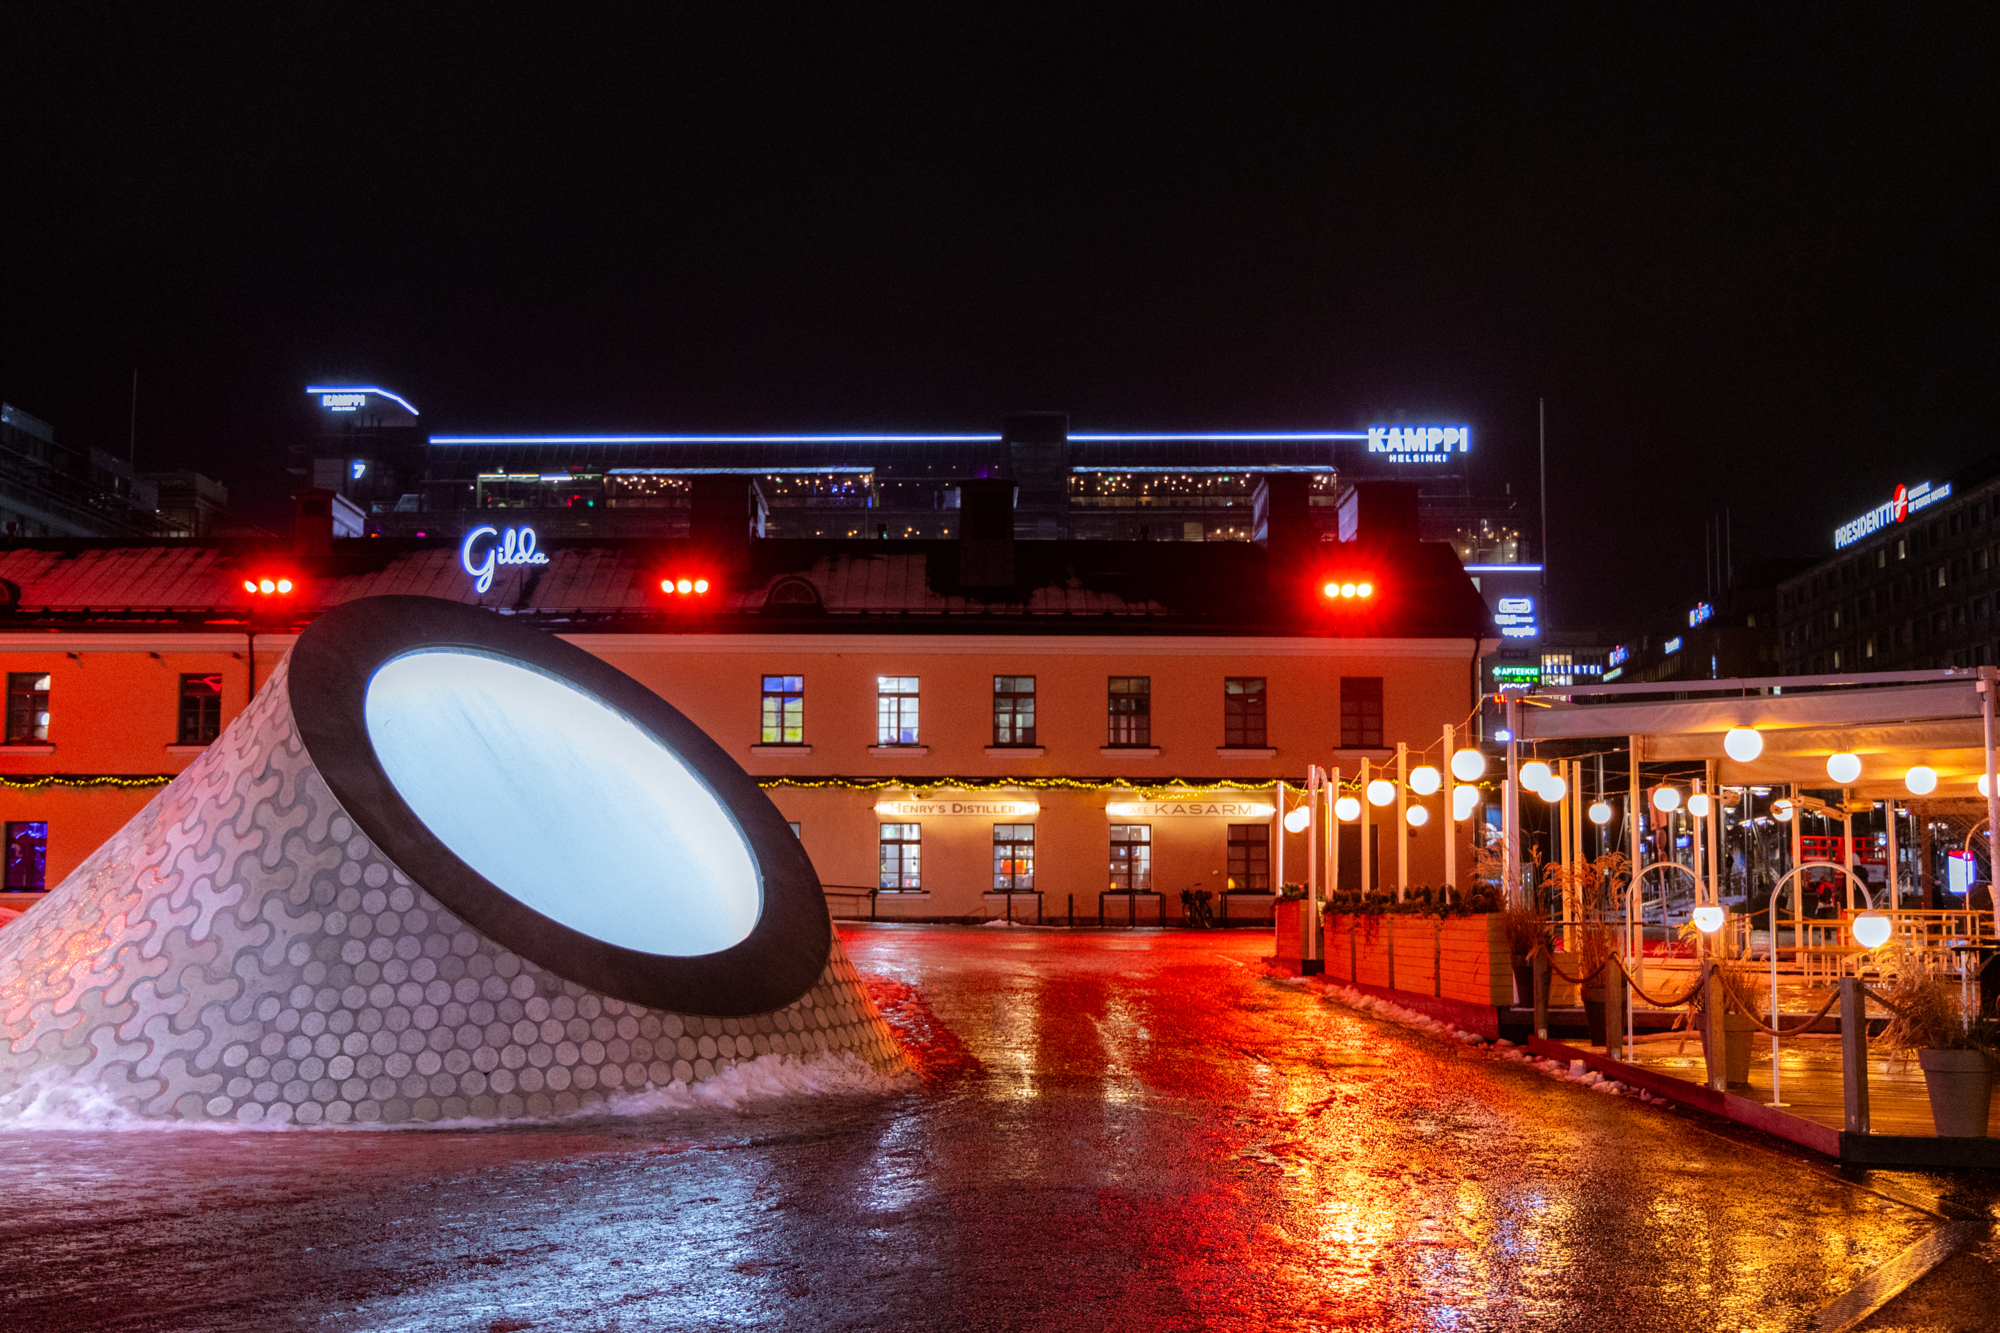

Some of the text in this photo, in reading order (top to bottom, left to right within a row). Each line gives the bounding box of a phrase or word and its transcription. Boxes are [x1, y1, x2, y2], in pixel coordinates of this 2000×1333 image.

[1368, 427, 1468, 453] KAMPPI
[1389, 453, 1447, 463] HELSINKI
[354, 463, 366, 479] 7
[1835, 499, 1894, 550] PRESIDENTTI
[462, 526, 550, 594] Gilda
[1502, 667, 1538, 676] APTEEKKI
[890, 802, 1023, 814] HENRY'S DISTILLERY
[1154, 803, 1257, 815] KASARMI
